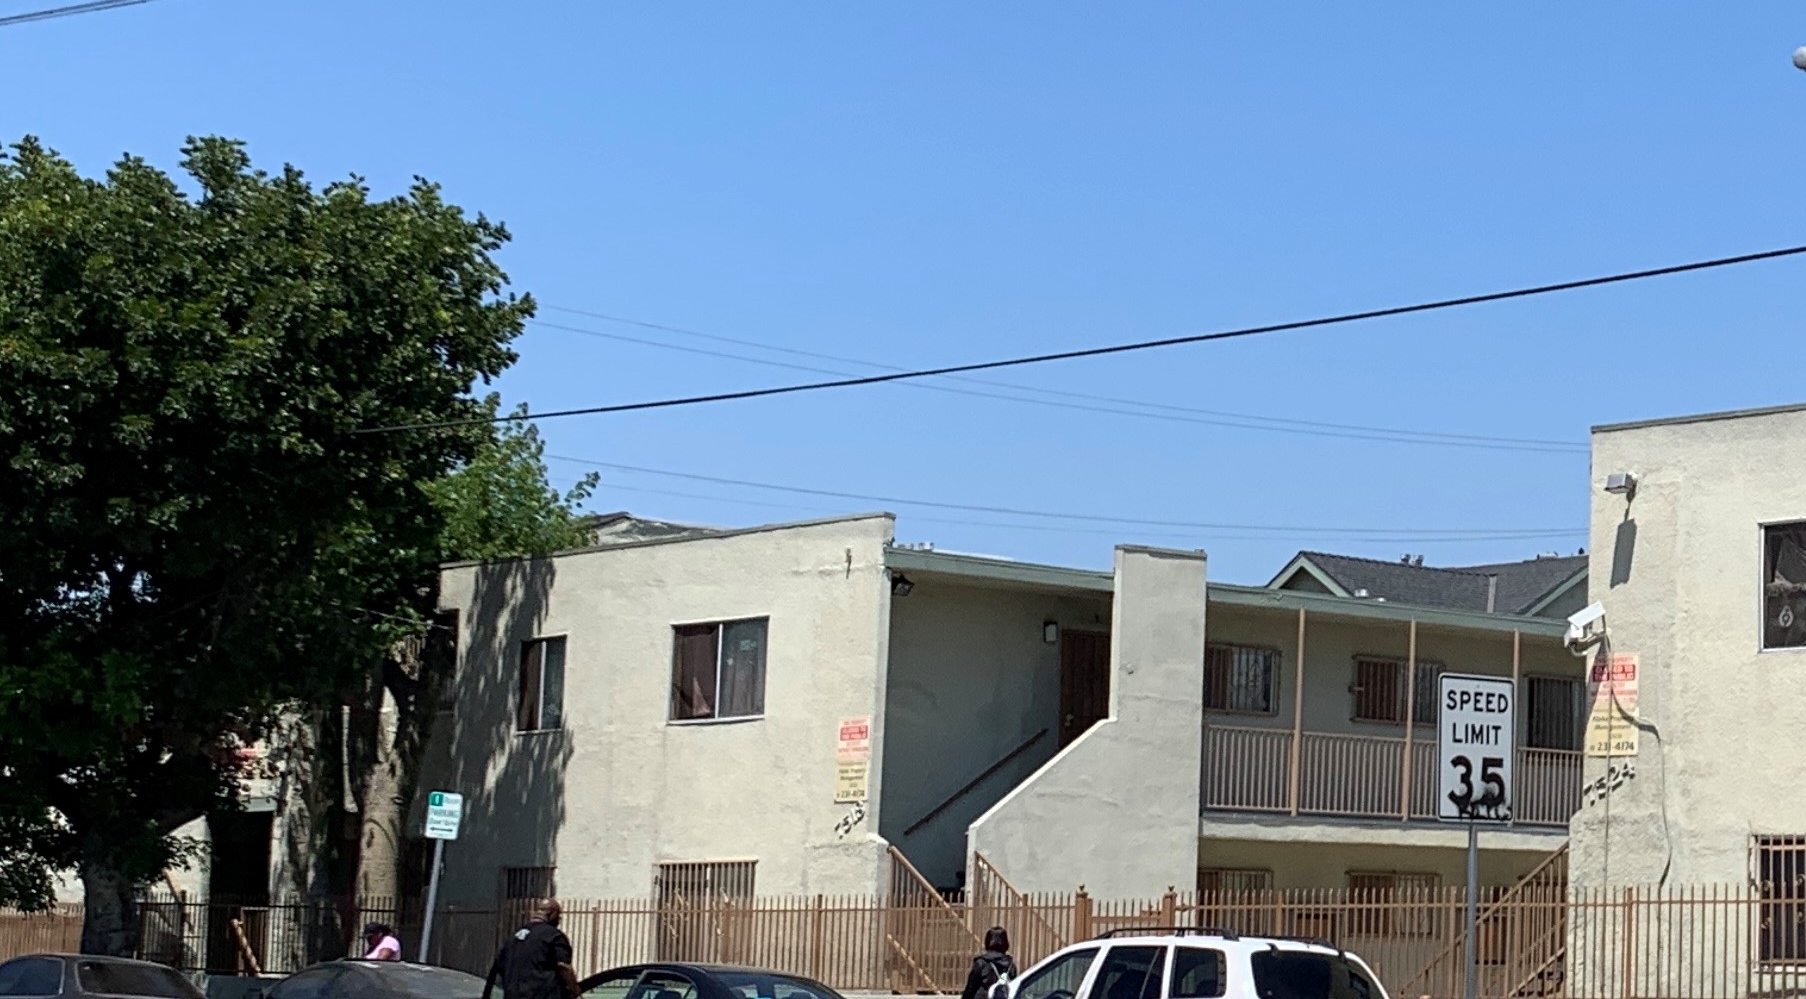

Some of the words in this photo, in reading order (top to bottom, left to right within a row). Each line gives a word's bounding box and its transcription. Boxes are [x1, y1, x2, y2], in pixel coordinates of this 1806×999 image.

[1446, 689, 1509, 714] SPEED
[1452, 722, 1502, 746] LIMIT
[1447, 755, 1506, 810] 35
